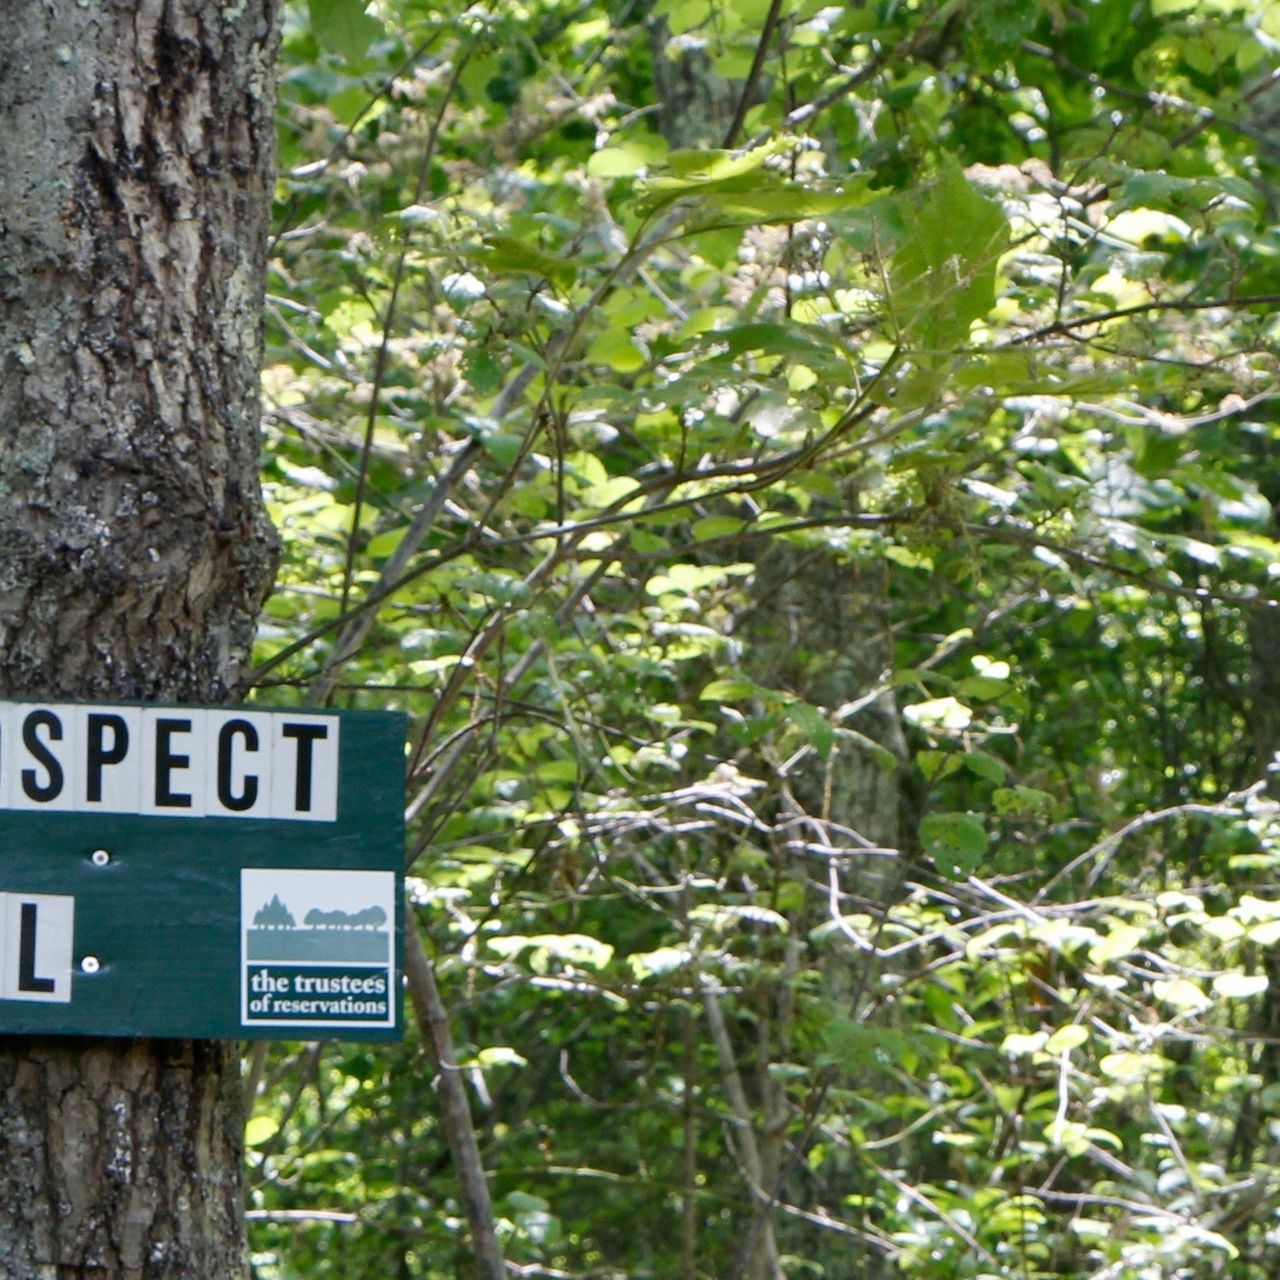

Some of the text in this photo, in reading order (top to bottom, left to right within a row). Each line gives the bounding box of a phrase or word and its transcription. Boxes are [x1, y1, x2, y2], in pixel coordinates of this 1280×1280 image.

[250, 968, 386, 993] the trustees
[249, 993, 386, 1014] of reservations
